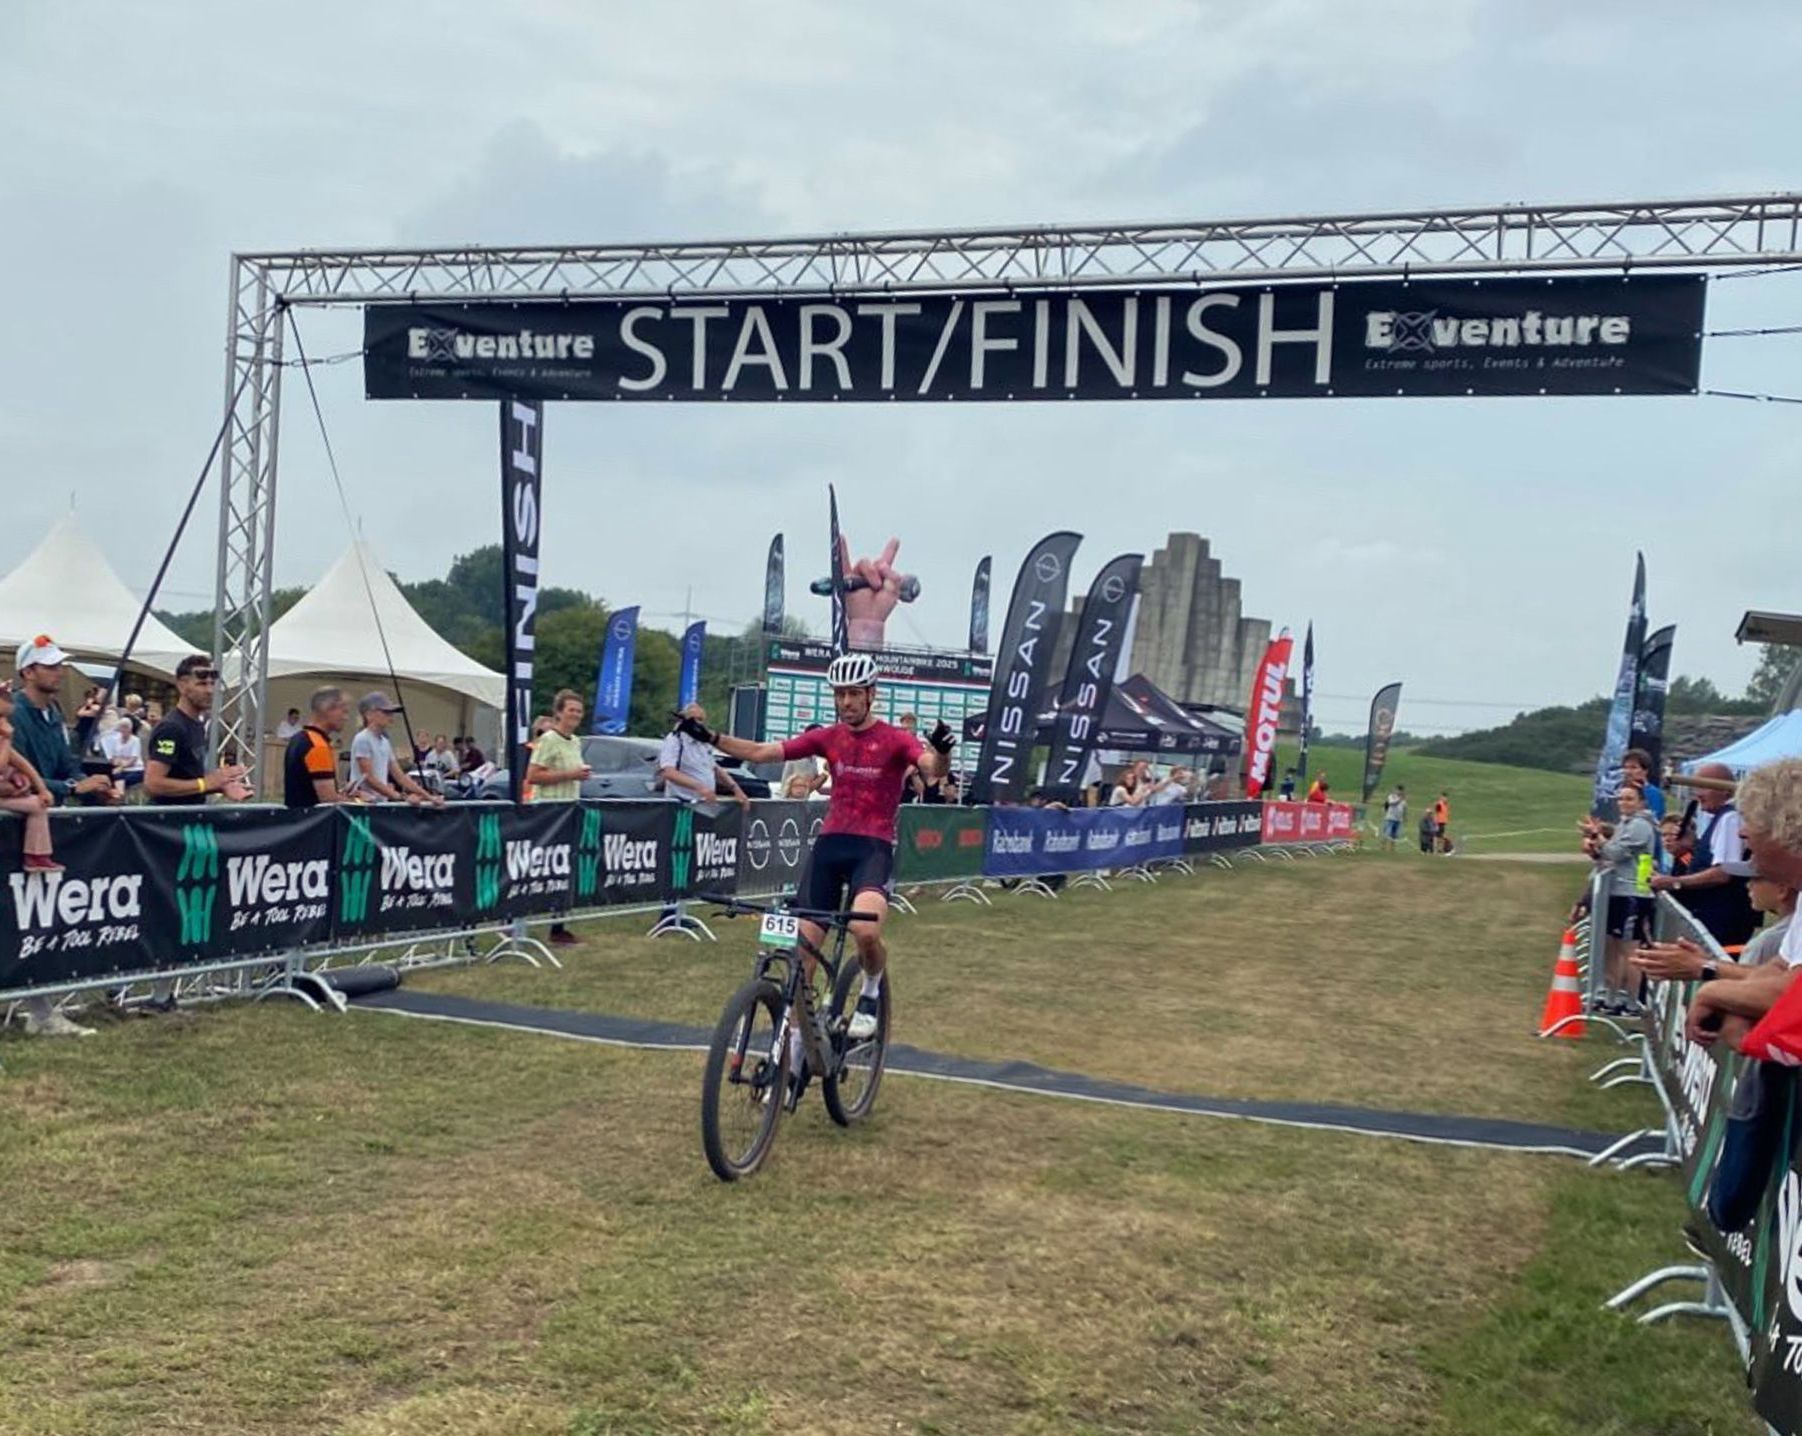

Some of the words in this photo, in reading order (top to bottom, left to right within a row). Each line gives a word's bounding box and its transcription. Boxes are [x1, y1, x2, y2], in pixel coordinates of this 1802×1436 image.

[618, 291, 1335, 394] START/FINISH
[511, 402, 540, 744] FINISH
[989, 600, 1046, 785] NISSAN
[1058, 618, 1113, 783] NISSAN
[1250, 662, 1286, 785] MOTUL
[380, 846, 456, 891] Wera
[506, 839, 571, 881] Wera
[603, 833, 657, 871] Wera
[695, 832, 738, 867] Wera
[9, 871, 143, 931] Wera
[227, 854, 329, 907] Wera
[764, 917, 797, 934] 615
